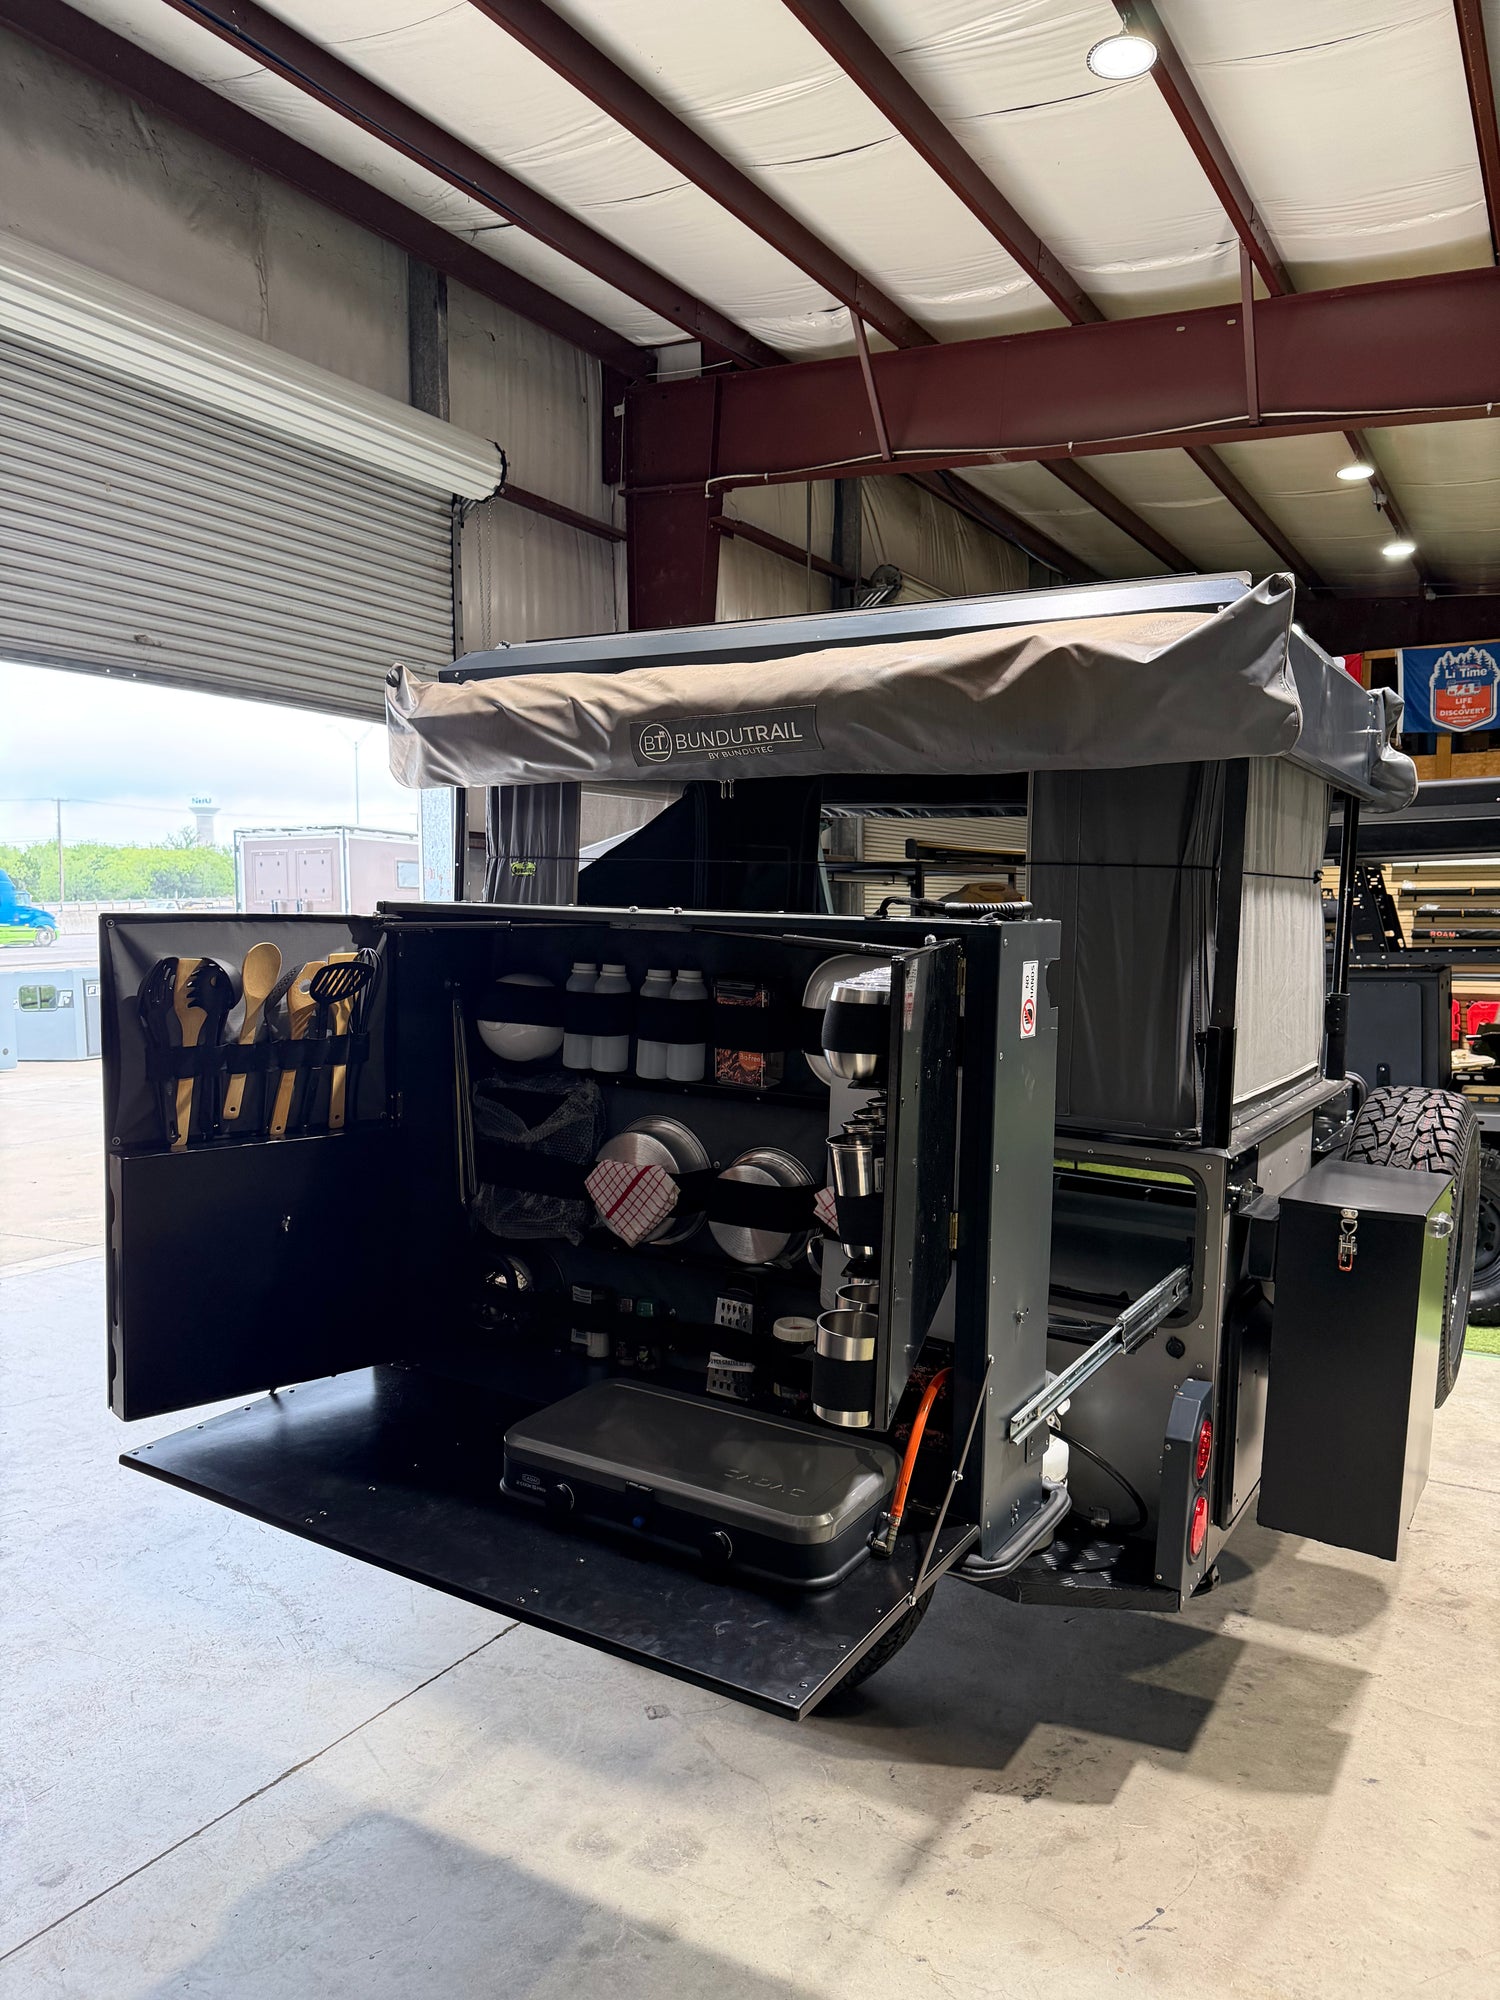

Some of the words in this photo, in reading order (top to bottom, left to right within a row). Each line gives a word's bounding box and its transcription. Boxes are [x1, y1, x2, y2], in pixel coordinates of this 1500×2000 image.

[1445, 669, 1456, 679] Li
[1459, 667, 1487, 678] Time
[1455, 697, 1473, 705] LIFE
[1440, 706, 1486, 716] DISCOVERY
[675, 721, 803, 750] BUNDUTRAIL
[708, 752, 720, 760] BY
[723, 745, 774, 759] BUNDUTEC
[1025, 975, 1030, 989] NO
